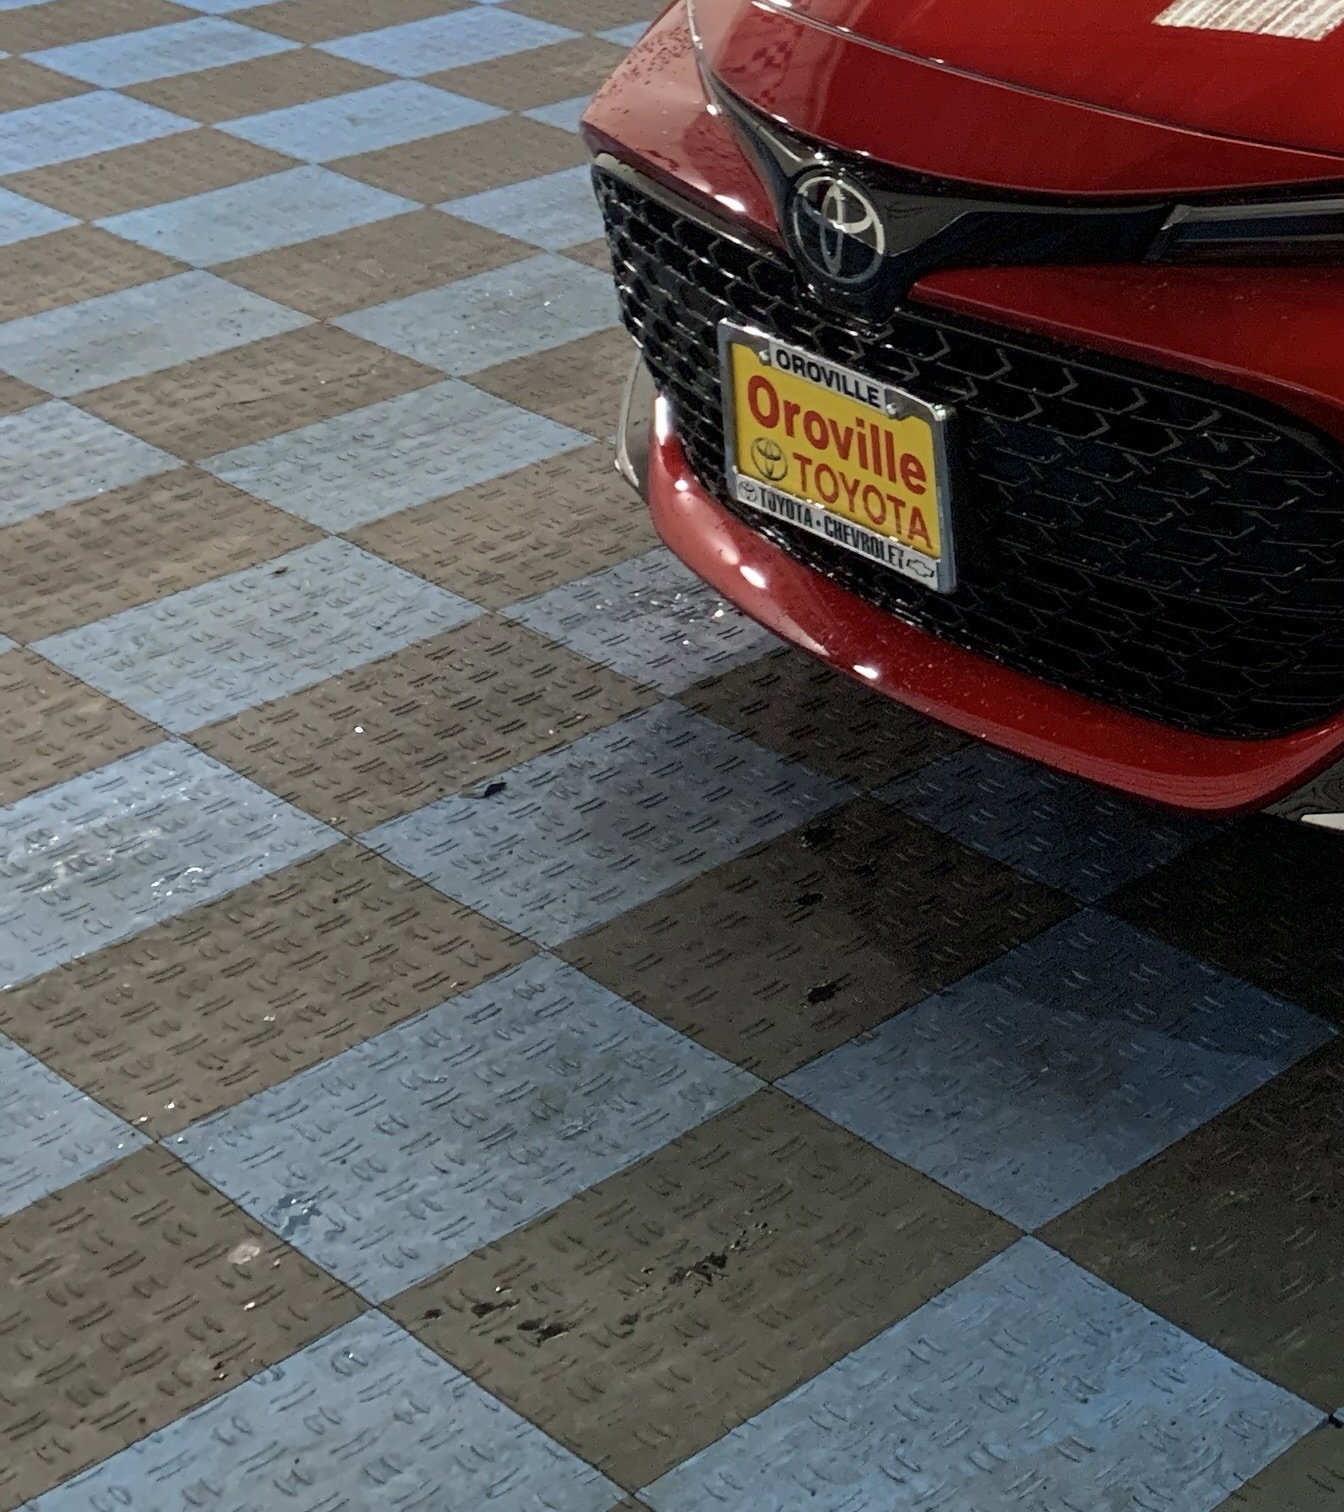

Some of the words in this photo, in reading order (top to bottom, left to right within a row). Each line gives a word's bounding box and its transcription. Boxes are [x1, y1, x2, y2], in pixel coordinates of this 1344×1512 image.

[775, 349, 880, 408] OROVILLE
[747, 375, 927, 495] Oroville
[759, 486, 813, 529] TOYOTA
[824, 515, 904, 570] CHEVROLET
[793, 452, 933, 549] TOYOTA
